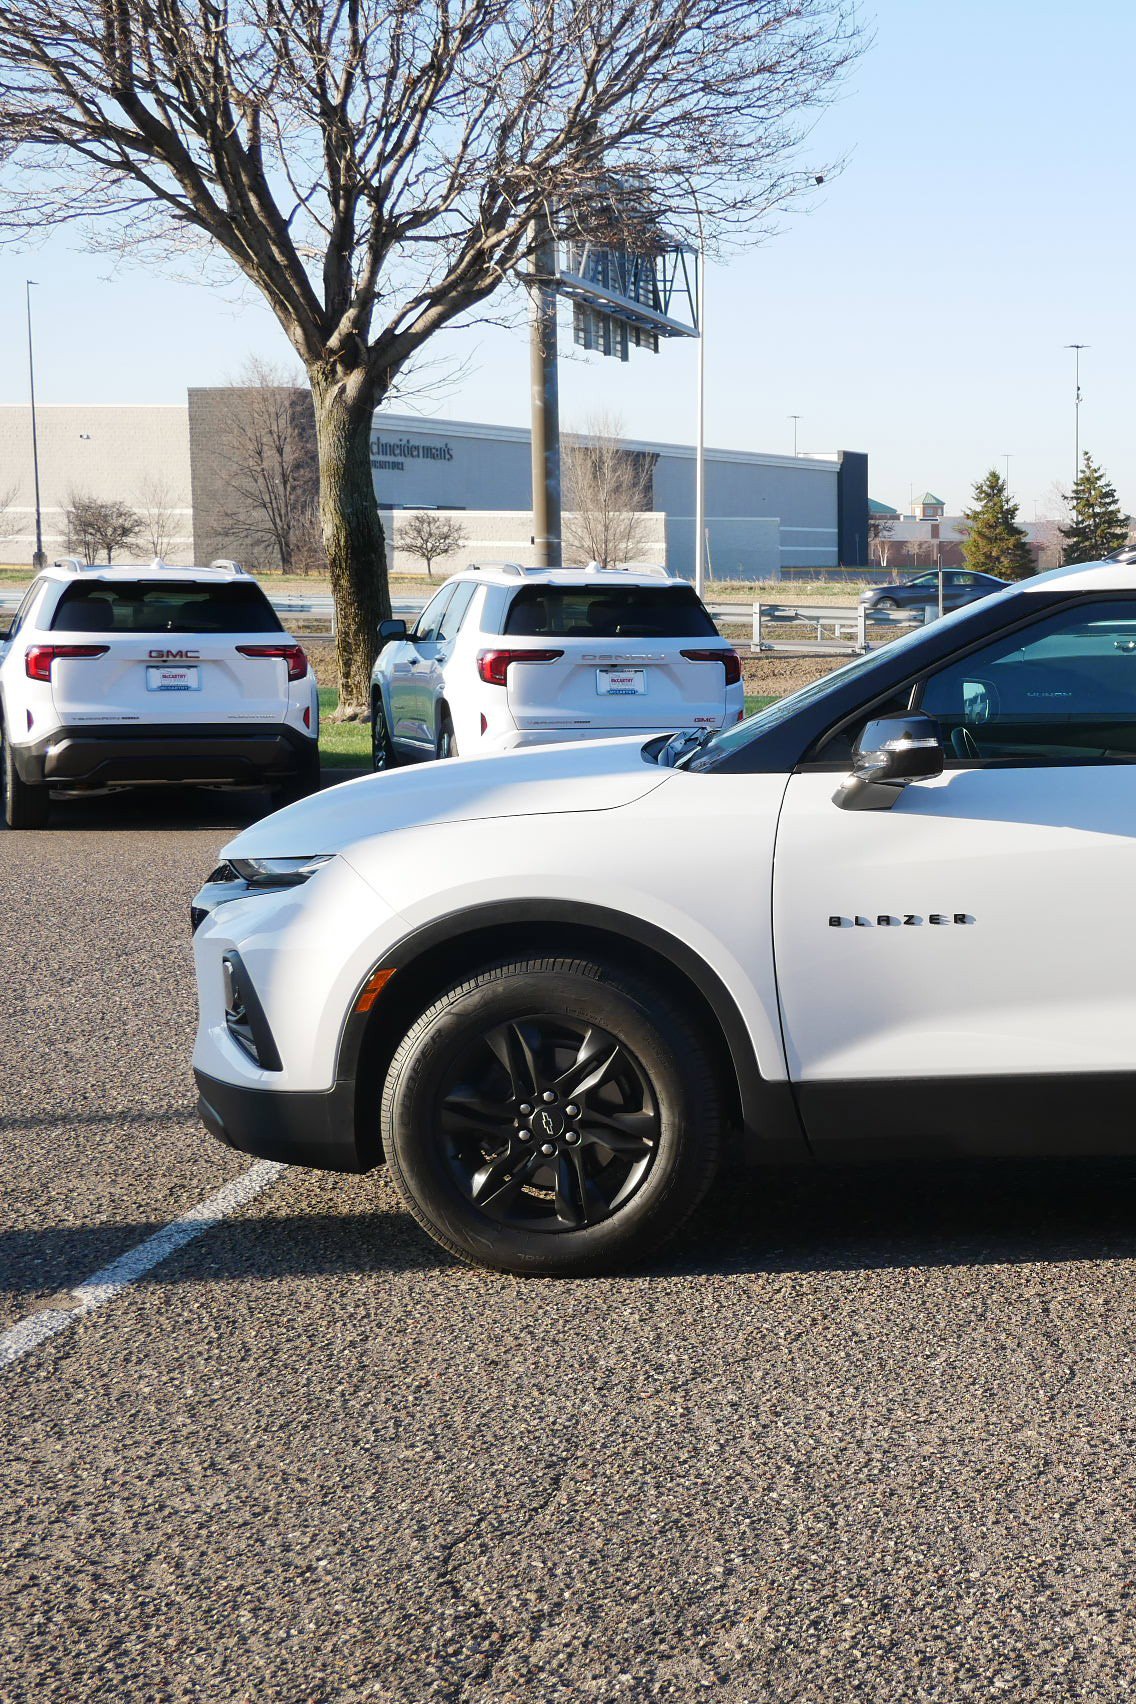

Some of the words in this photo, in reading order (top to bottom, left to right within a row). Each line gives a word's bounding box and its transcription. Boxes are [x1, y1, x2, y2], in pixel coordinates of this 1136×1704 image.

[370, 436, 454, 461] chneiderman's
[149, 650, 200, 659] GMC
[828, 913, 967, 927] BLAZER
